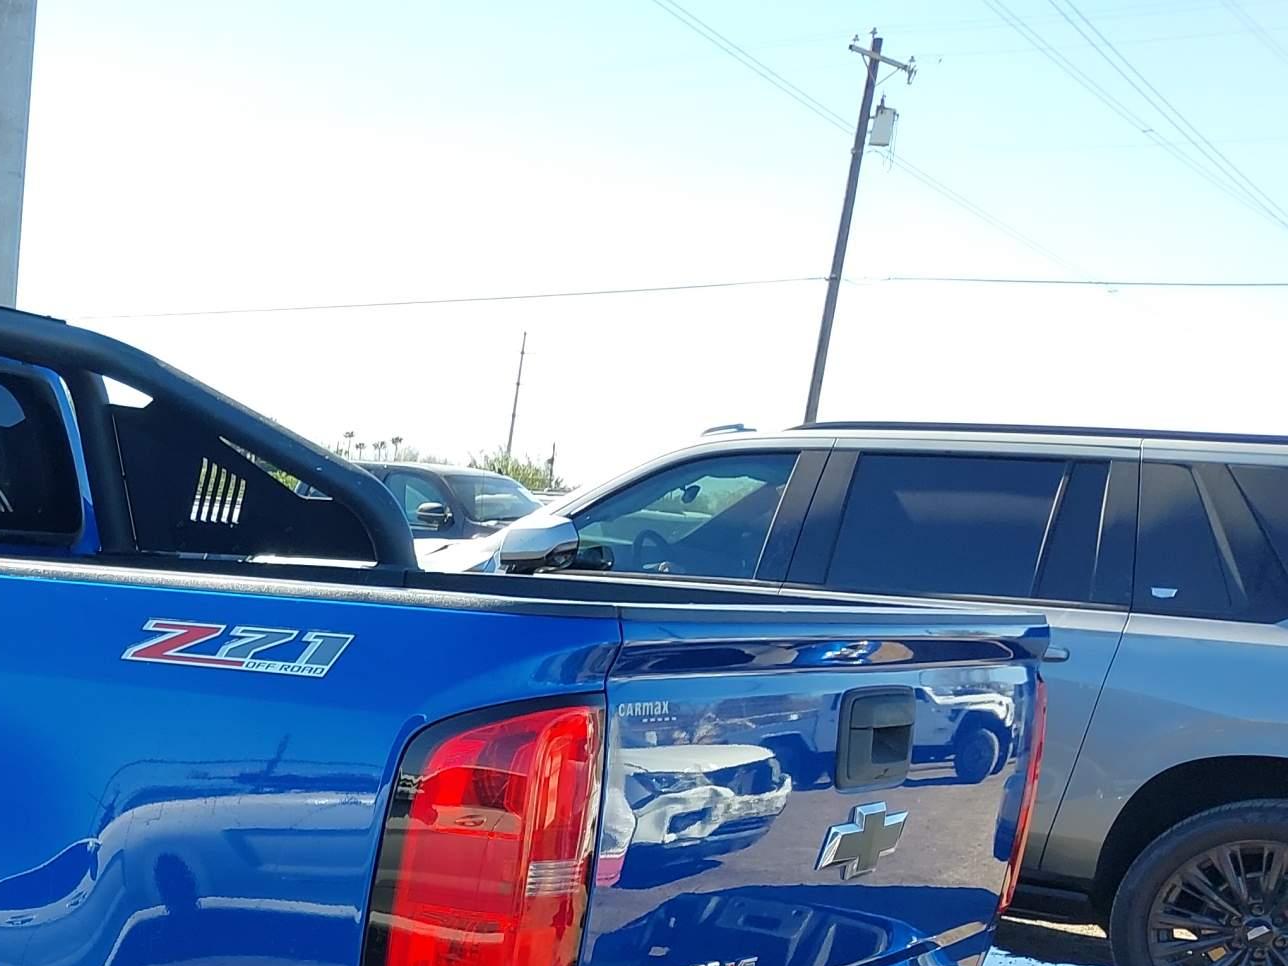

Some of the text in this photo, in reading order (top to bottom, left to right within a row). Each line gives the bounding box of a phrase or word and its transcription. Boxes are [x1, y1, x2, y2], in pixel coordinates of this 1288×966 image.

[121, 619, 355, 668] Z71
[245, 661, 326, 675] OFF ROAD
